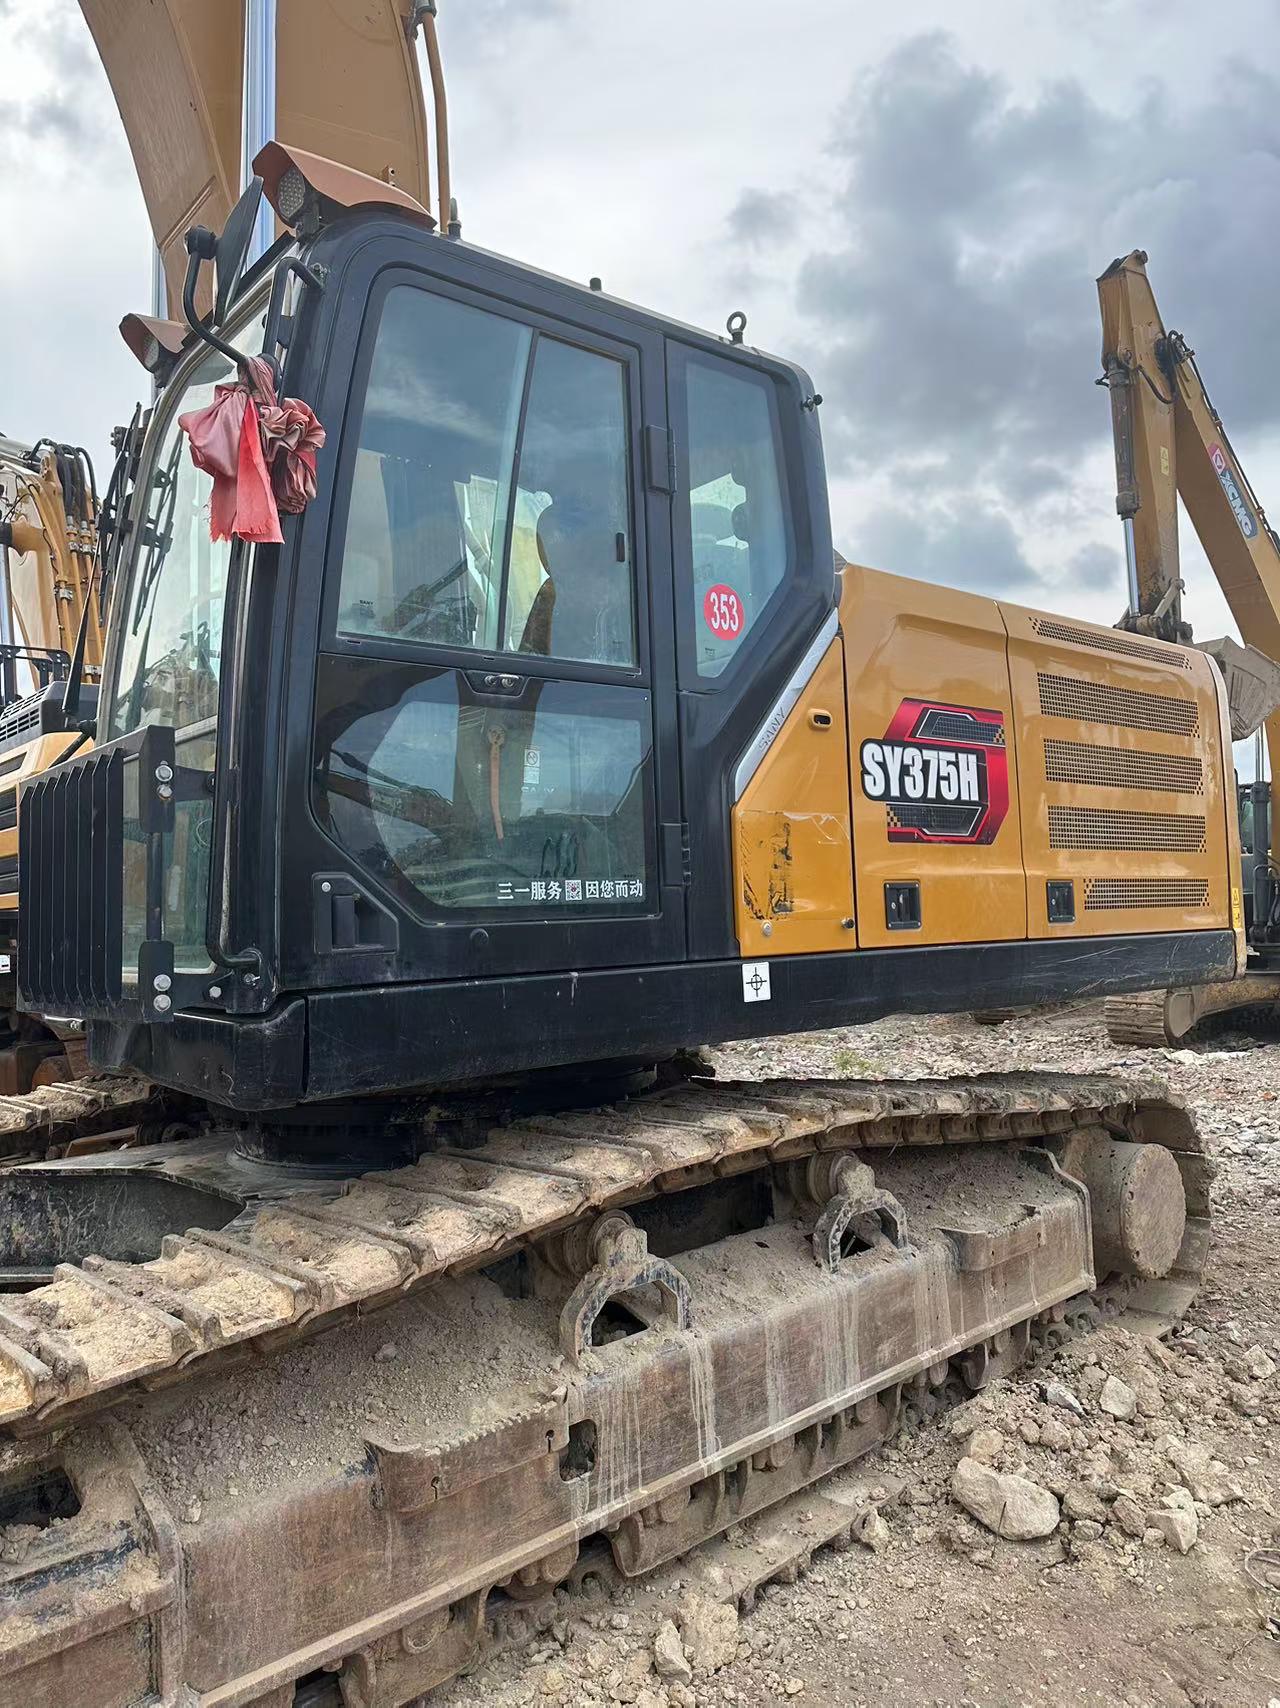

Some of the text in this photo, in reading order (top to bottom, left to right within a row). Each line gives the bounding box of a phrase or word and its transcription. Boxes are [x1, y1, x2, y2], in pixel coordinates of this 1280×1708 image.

[1220, 470, 1252, 535] XCMG
[710, 592, 739, 632] 353
[862, 742, 979, 801] SY375H
[497, 879, 643, 900] 三一服务 因您而动
